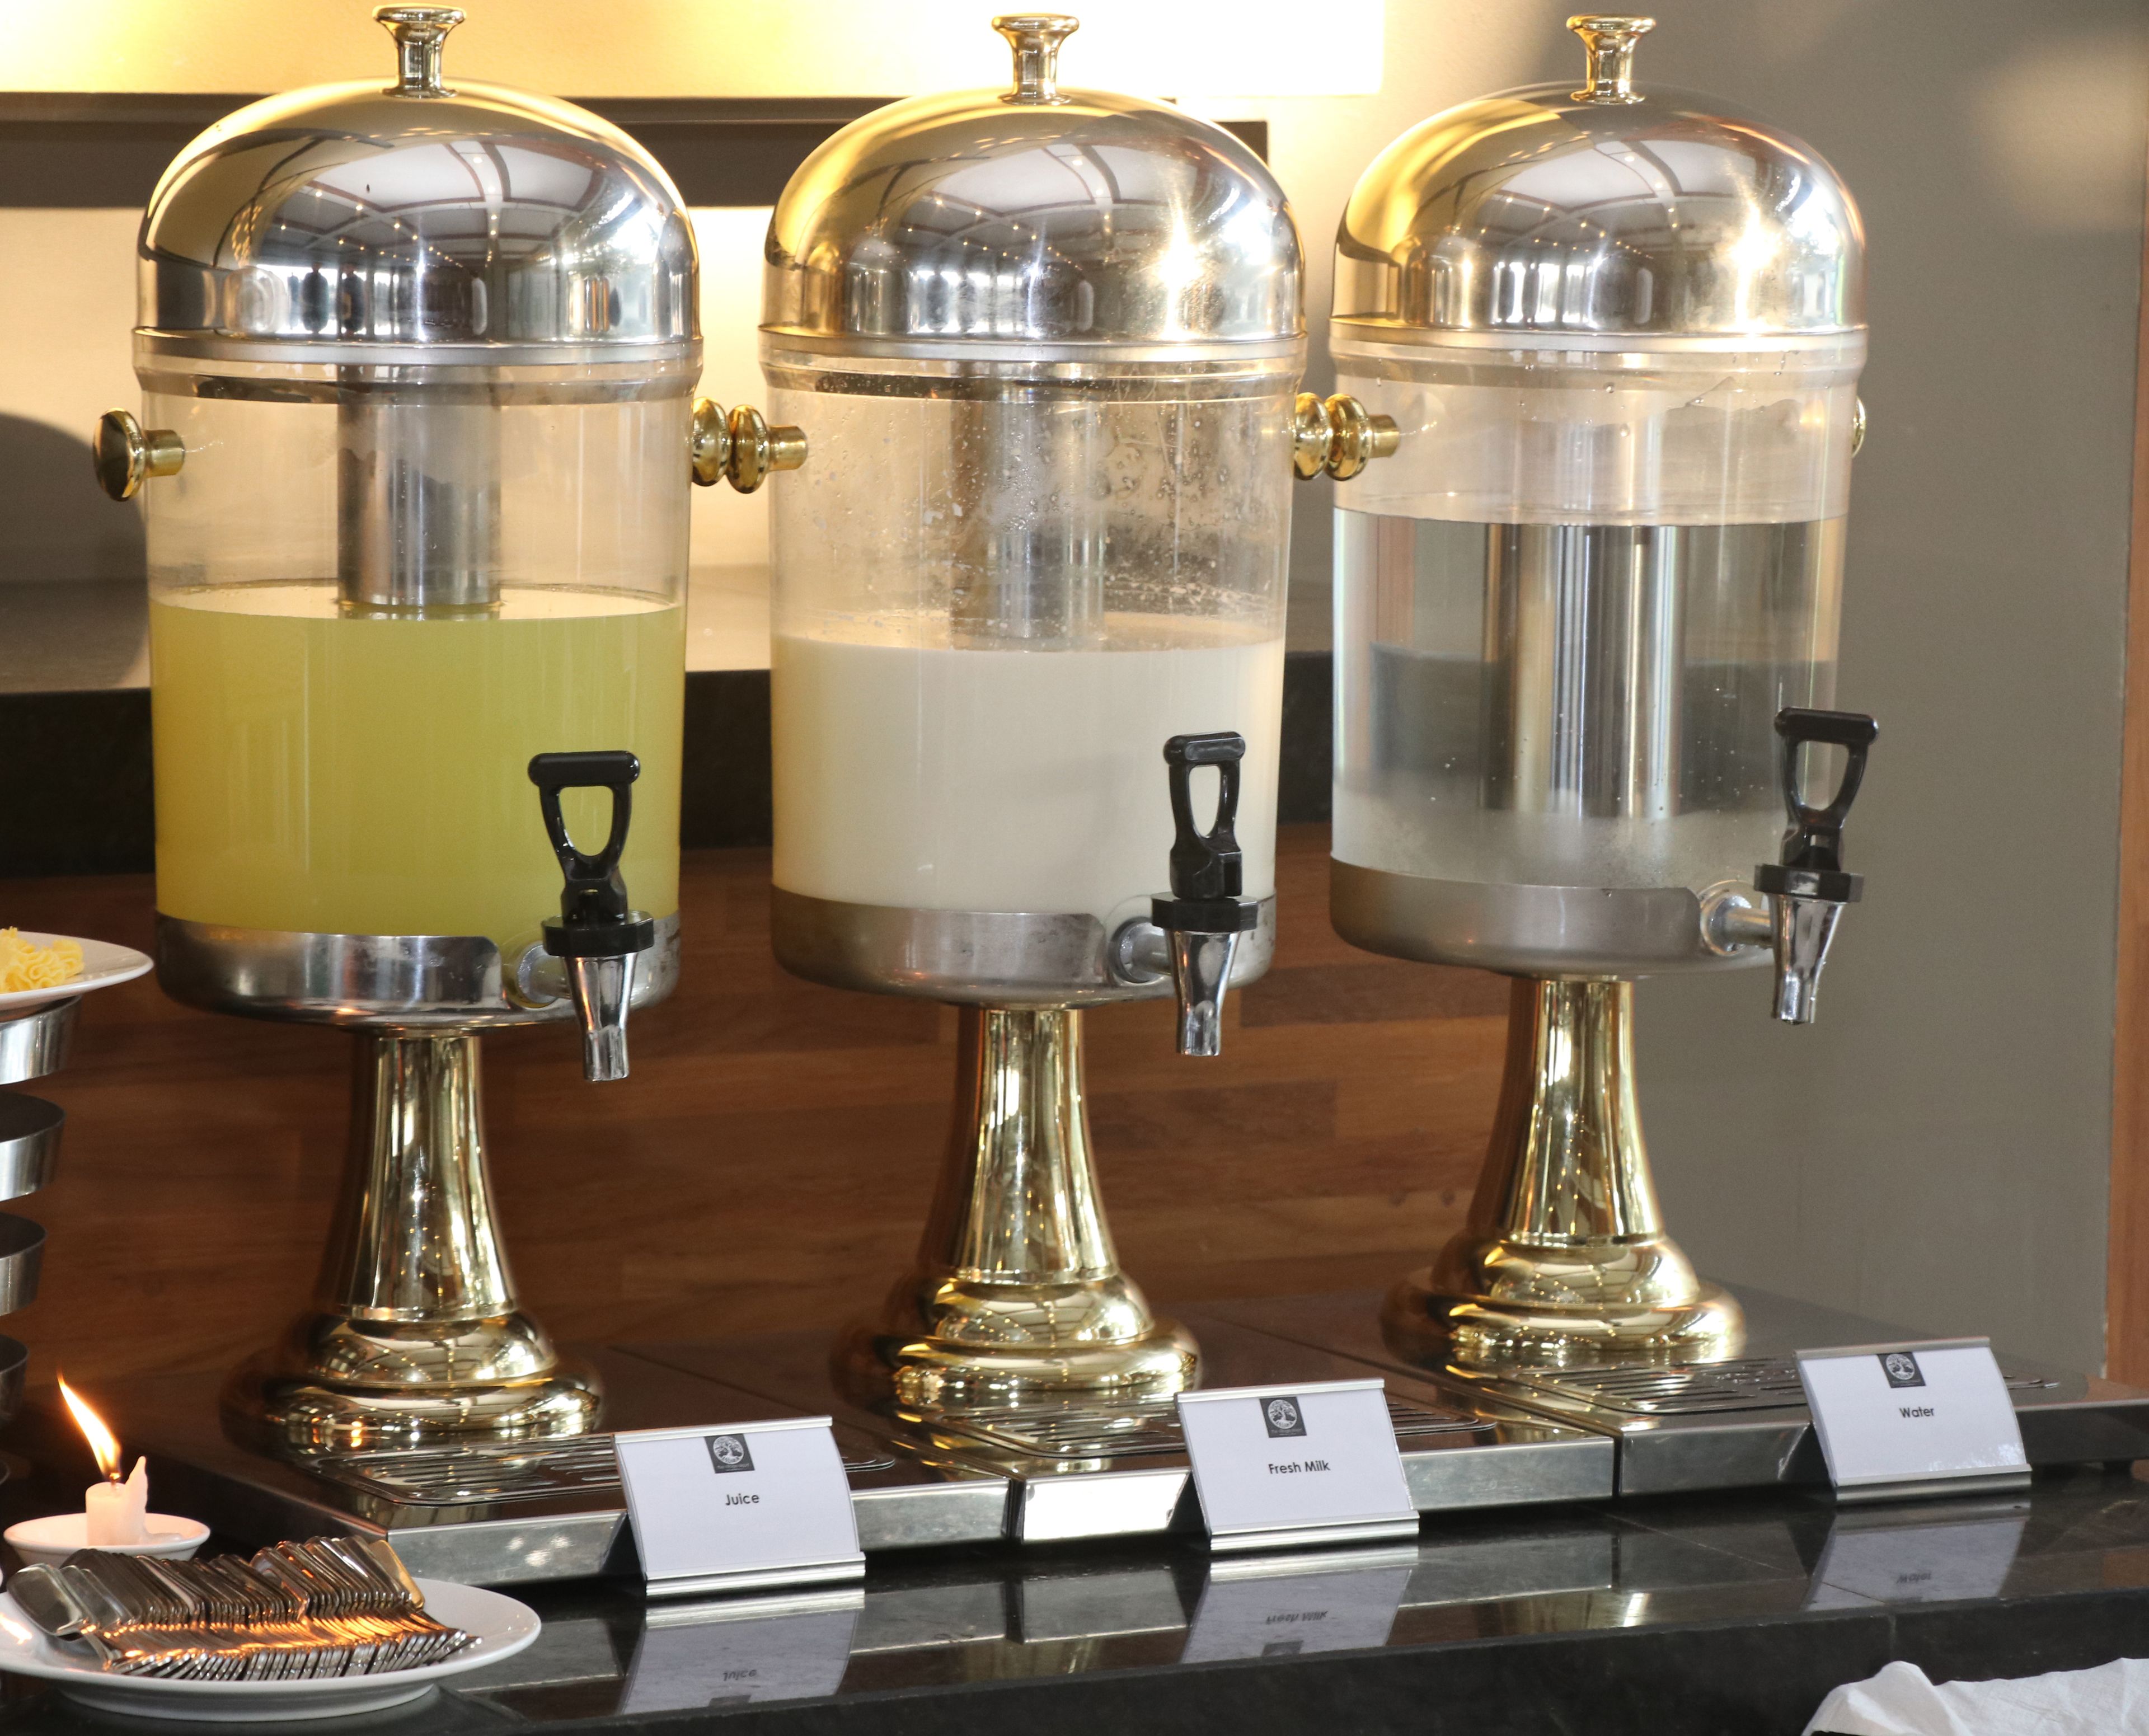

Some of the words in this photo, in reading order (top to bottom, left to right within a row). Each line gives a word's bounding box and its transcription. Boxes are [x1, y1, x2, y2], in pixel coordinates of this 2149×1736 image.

[1899, 1406, 1934, 1418] Water
[1268, 1462, 1302, 1474] Fresh
[1305, 1460, 1331, 1472] Milk
[725, 1493, 759, 1506] Juice
